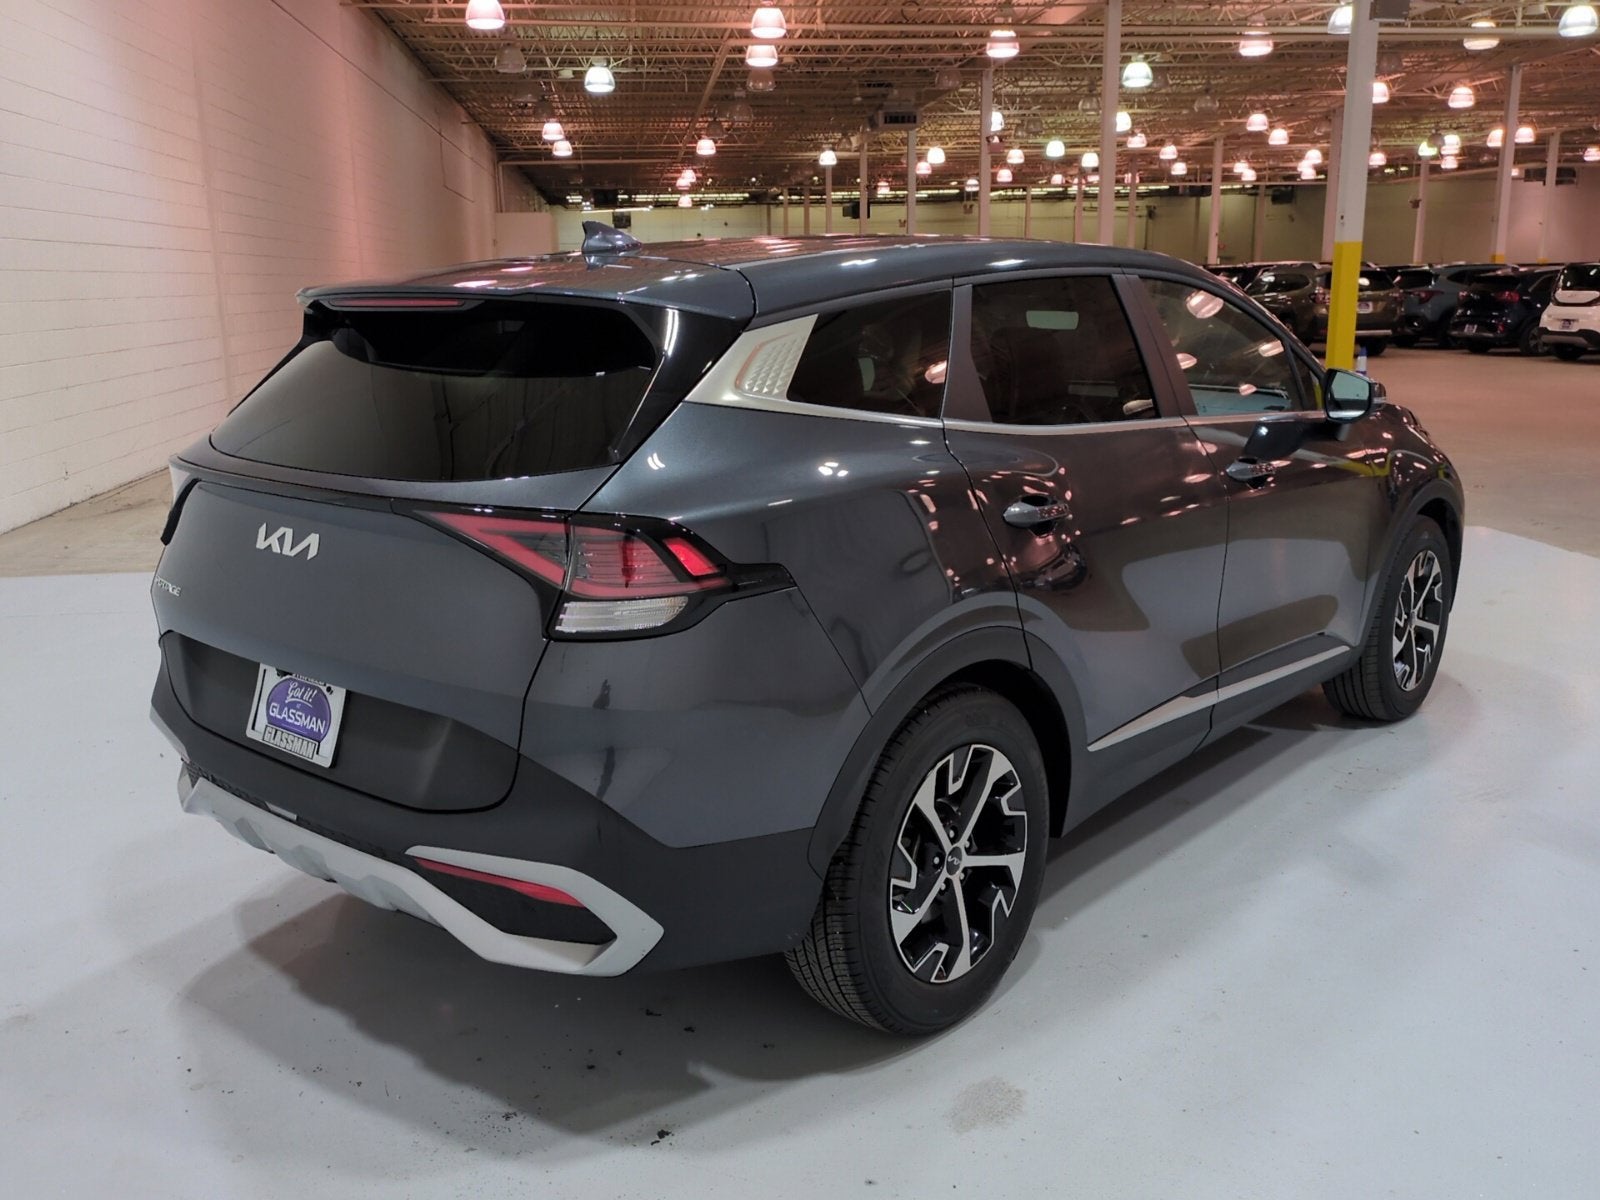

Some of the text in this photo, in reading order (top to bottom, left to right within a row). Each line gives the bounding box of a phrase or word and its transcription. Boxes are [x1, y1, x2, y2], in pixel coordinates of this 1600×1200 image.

[256, 522, 320, 560] KIA
[287, 681, 318, 702] Got it!
[269, 702, 326, 734] GLASSMAN
[264, 727, 316, 758] GLASSMAN
